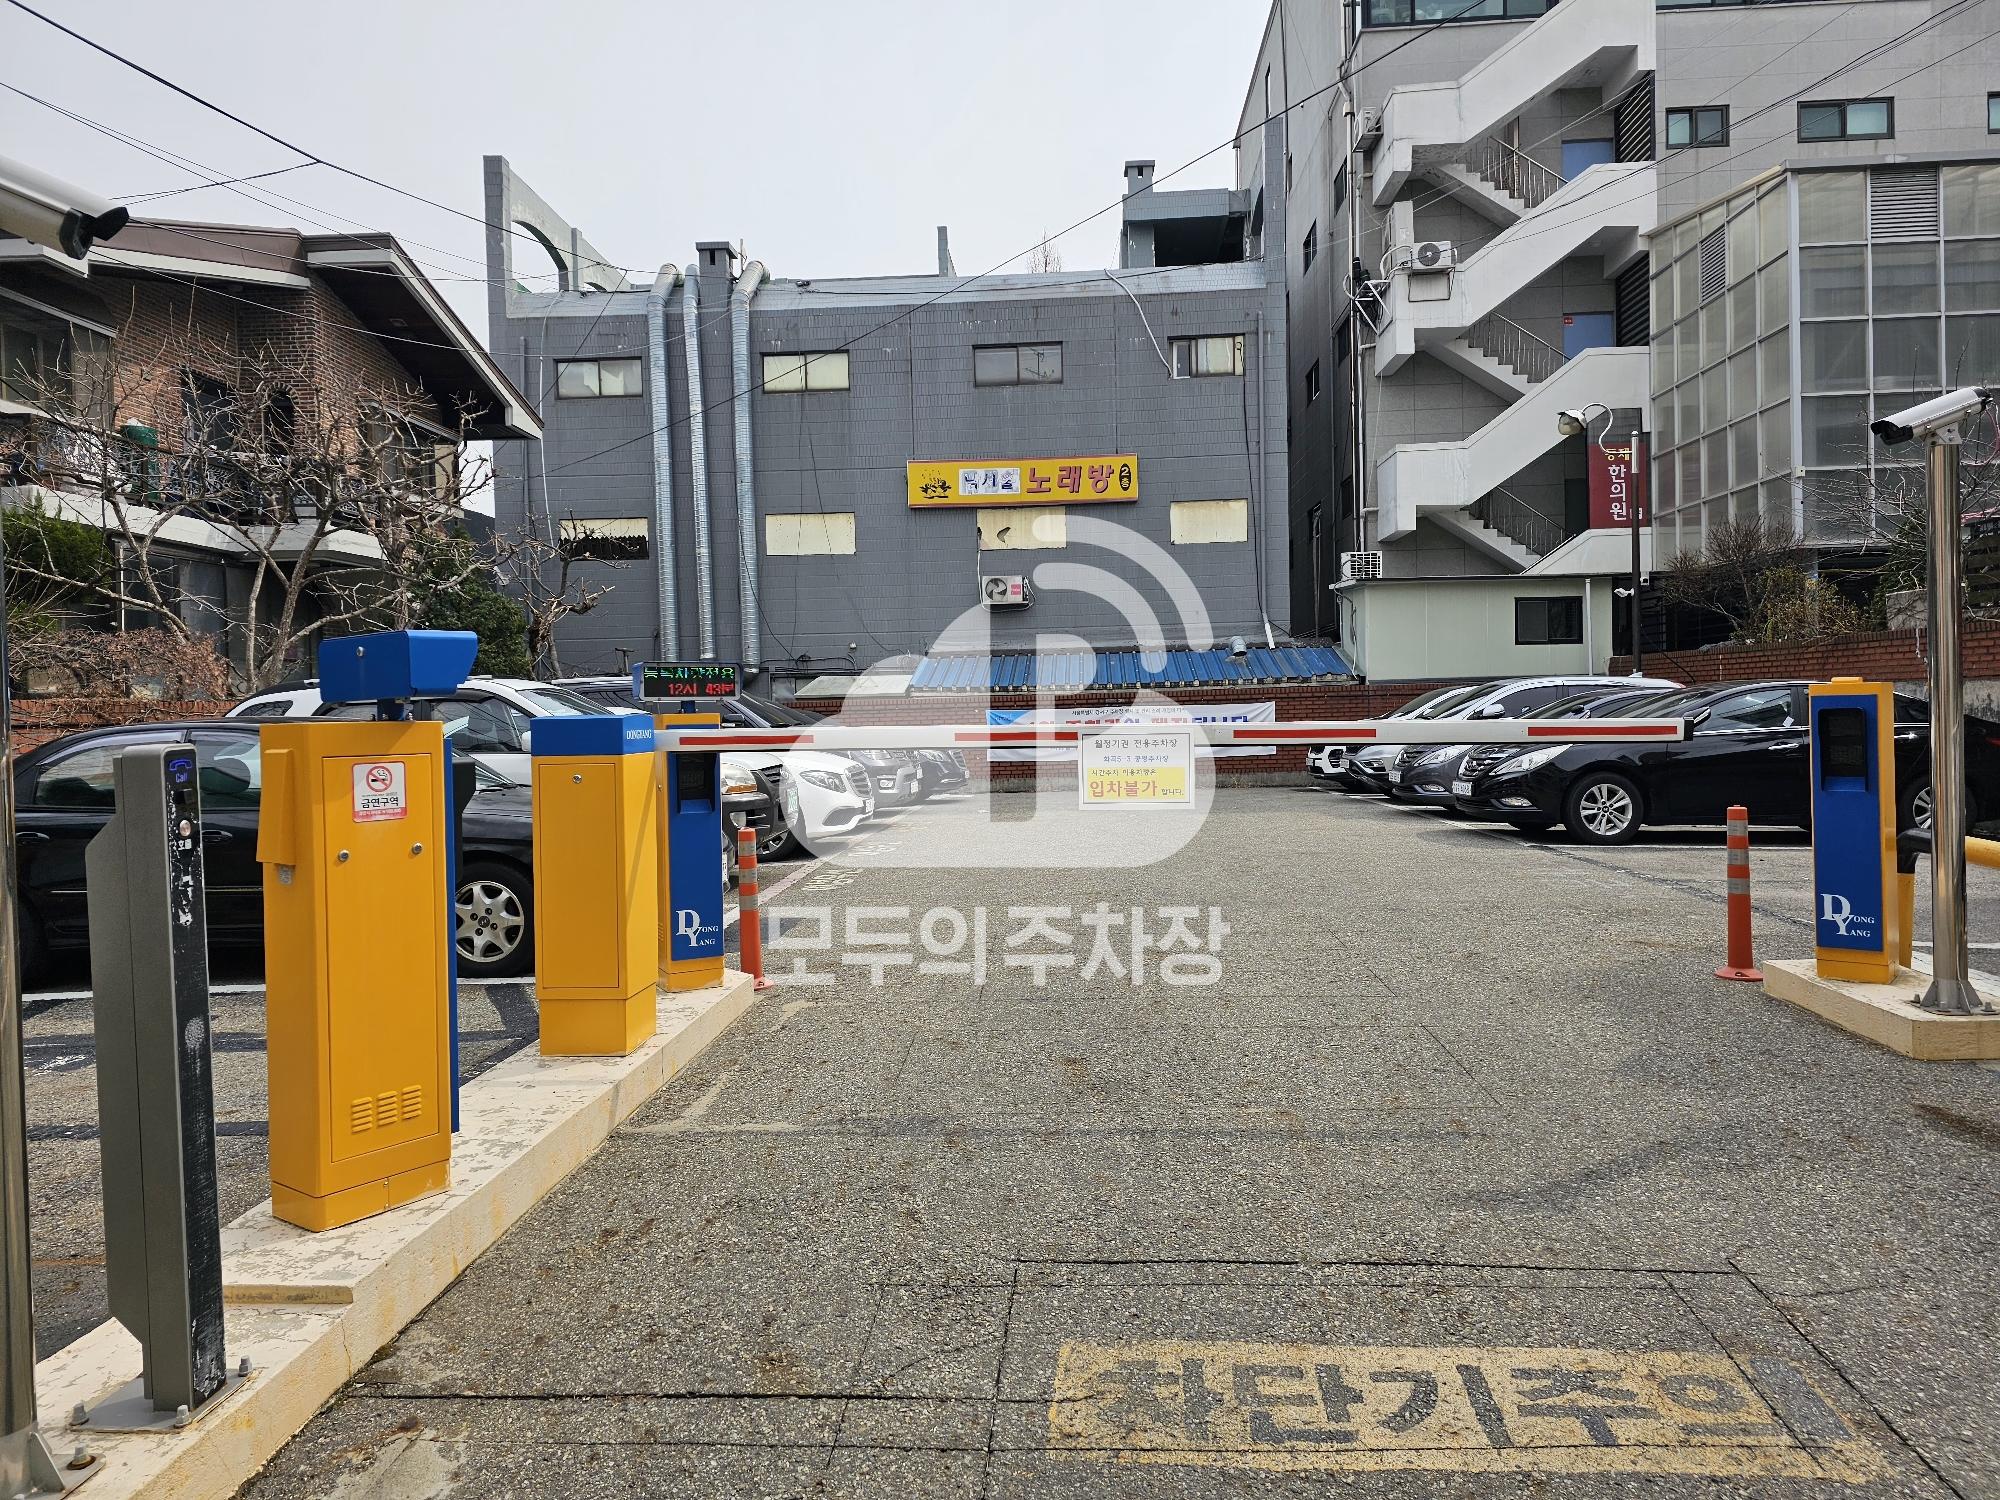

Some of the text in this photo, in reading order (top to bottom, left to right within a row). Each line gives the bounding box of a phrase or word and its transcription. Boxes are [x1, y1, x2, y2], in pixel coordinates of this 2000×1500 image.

[1026, 464, 1115, 494] 노래방
[1607, 464, 1627, 521] 한의원
[1094, 738, 1178, 749] 월정기권 전용주차장
[175, 773, 188, 782] Call
[1089, 780, 1158, 798] 입차불가
[361, 796, 399, 809] 금연구역
